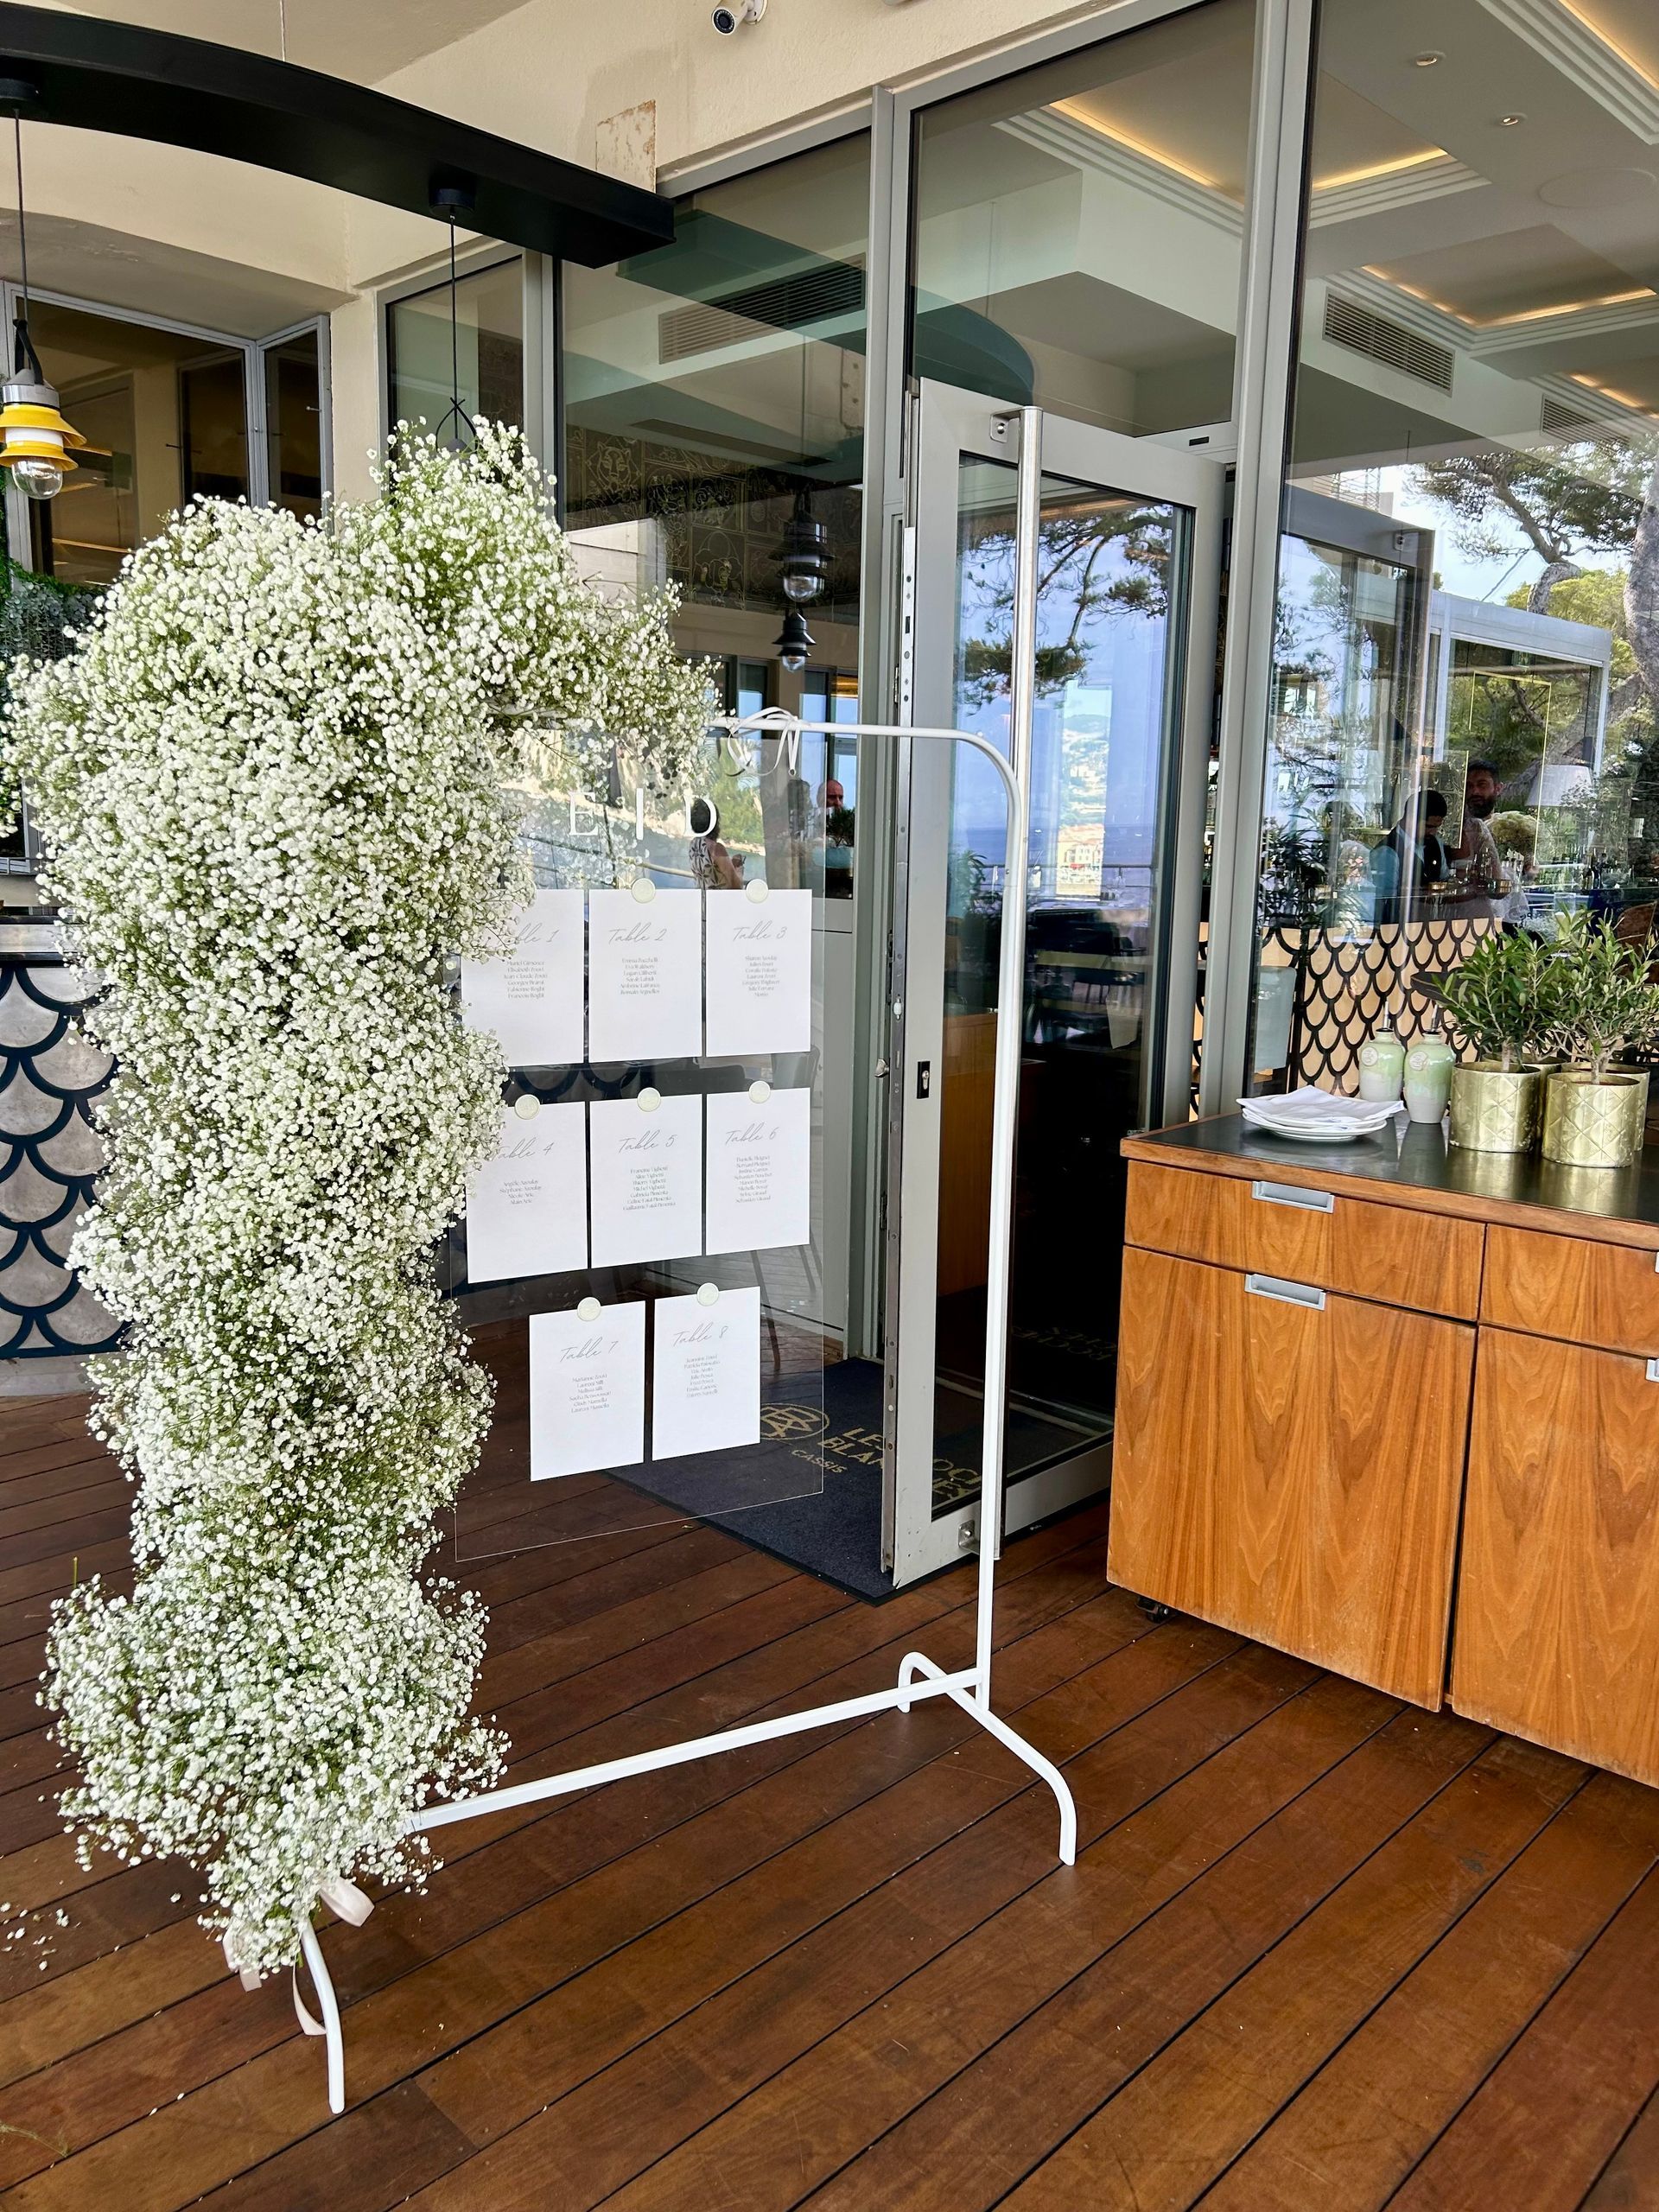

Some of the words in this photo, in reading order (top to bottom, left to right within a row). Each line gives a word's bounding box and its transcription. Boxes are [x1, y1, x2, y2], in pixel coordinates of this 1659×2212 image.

[569, 791, 598, 836] E
[683, 795, 717, 838] D
[546, 929, 560, 942] 1
[608, 922, 651, 944] Table
[654, 928, 668, 942] 2
[733, 919, 772, 942] Table
[776, 926, 788, 938] 3
[618, 1130, 659, 1154] Table
[664, 1134, 677, 1147] 5
[725, 1122, 766, 1146] Table
[769, 1127, 779, 1141] 6
[543, 1142, 555, 1156] 4
[673, 1322, 715, 1346] Table
[718, 1325, 729, 1339] 8
[559, 1337, 602, 1363] Table
[607, 1341, 619, 1354] 7
[791, 1448, 848, 1473] CASSIS
